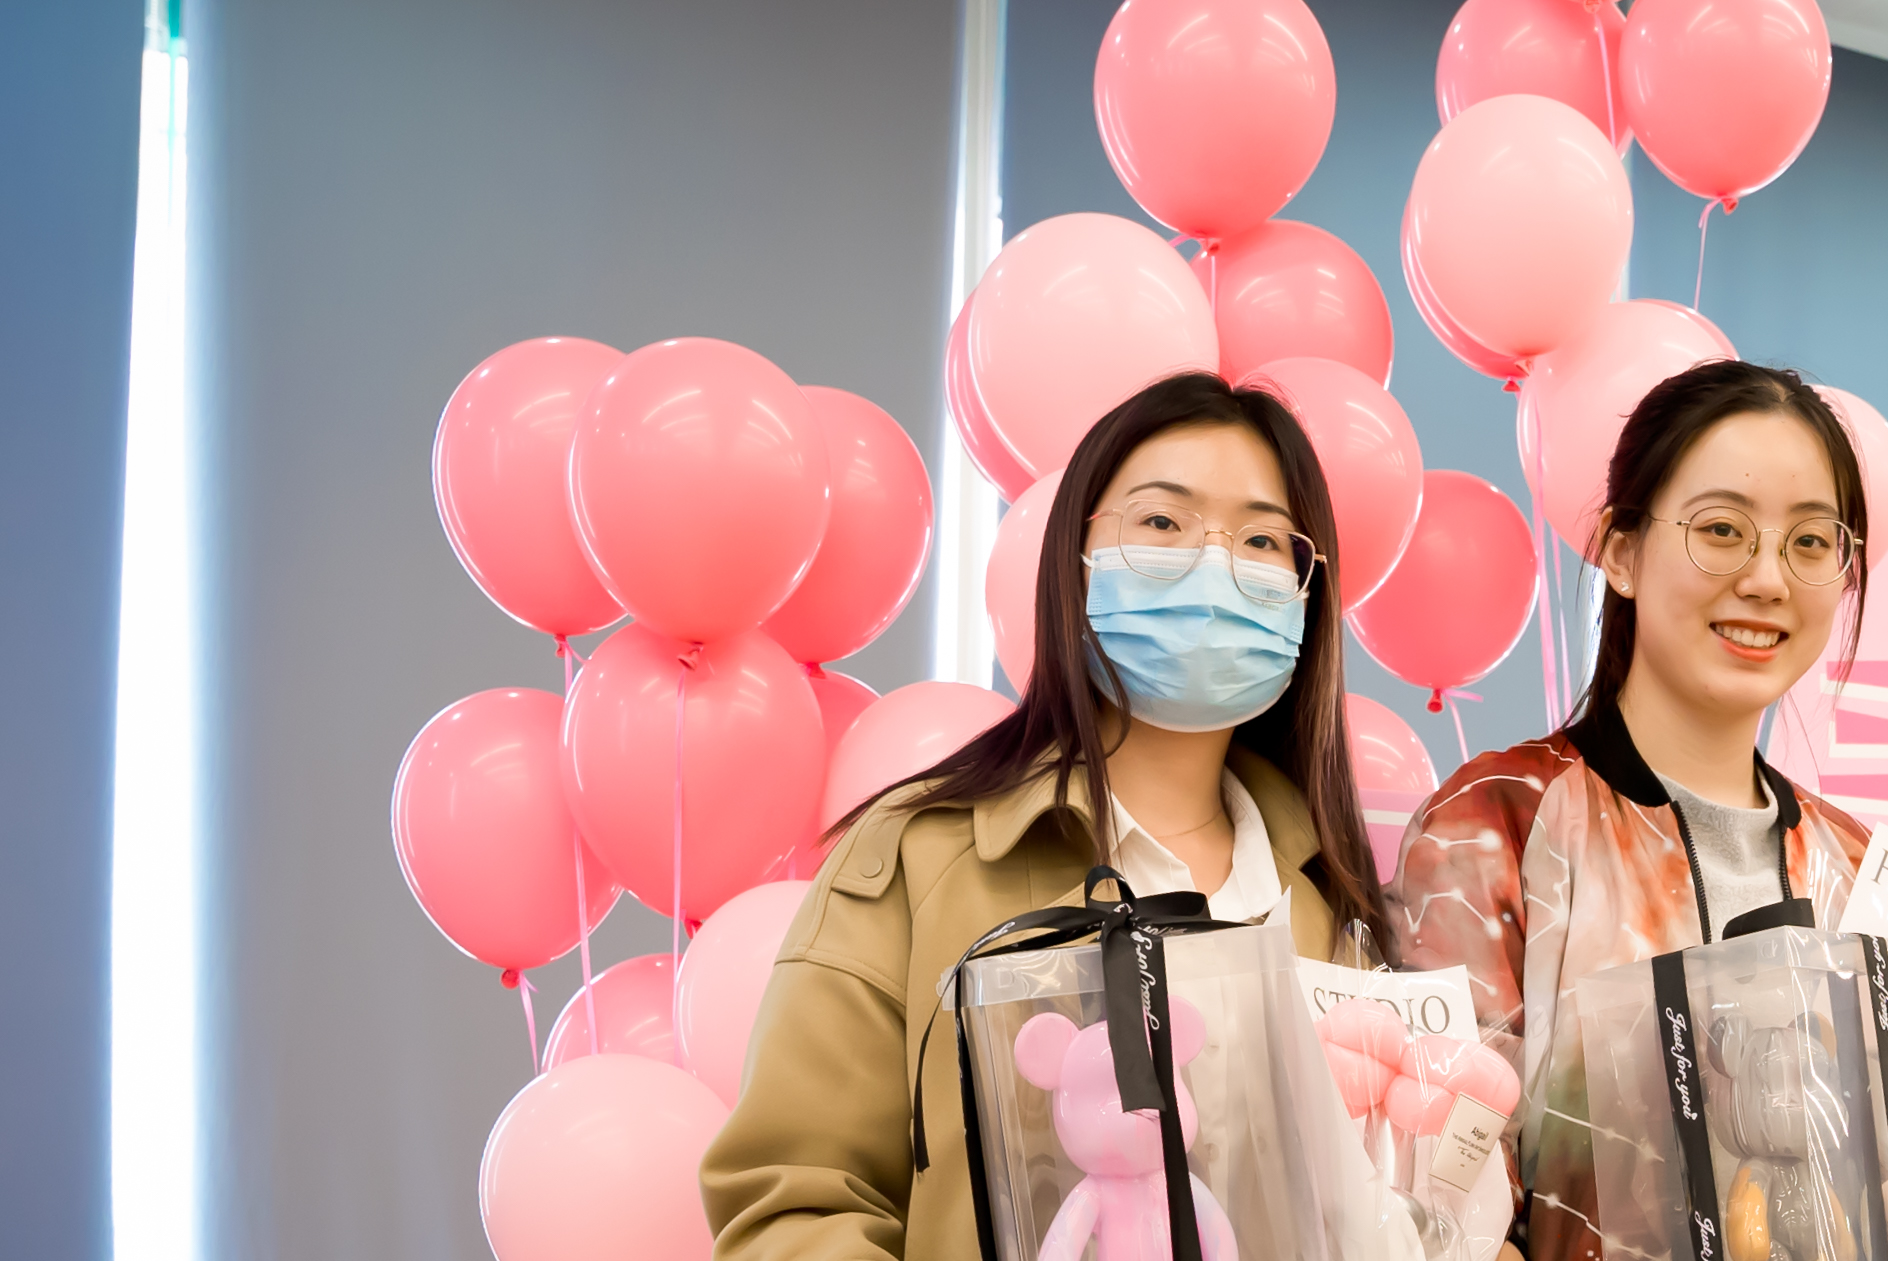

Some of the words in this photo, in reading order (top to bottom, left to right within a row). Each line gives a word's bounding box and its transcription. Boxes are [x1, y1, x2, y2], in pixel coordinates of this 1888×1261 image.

[1665, 1006, 1688, 1053] Just
[1671, 1045, 1692, 1082] for
[1674, 1077, 1697, 1121] you
[1694, 1210, 1715, 1258] Just
